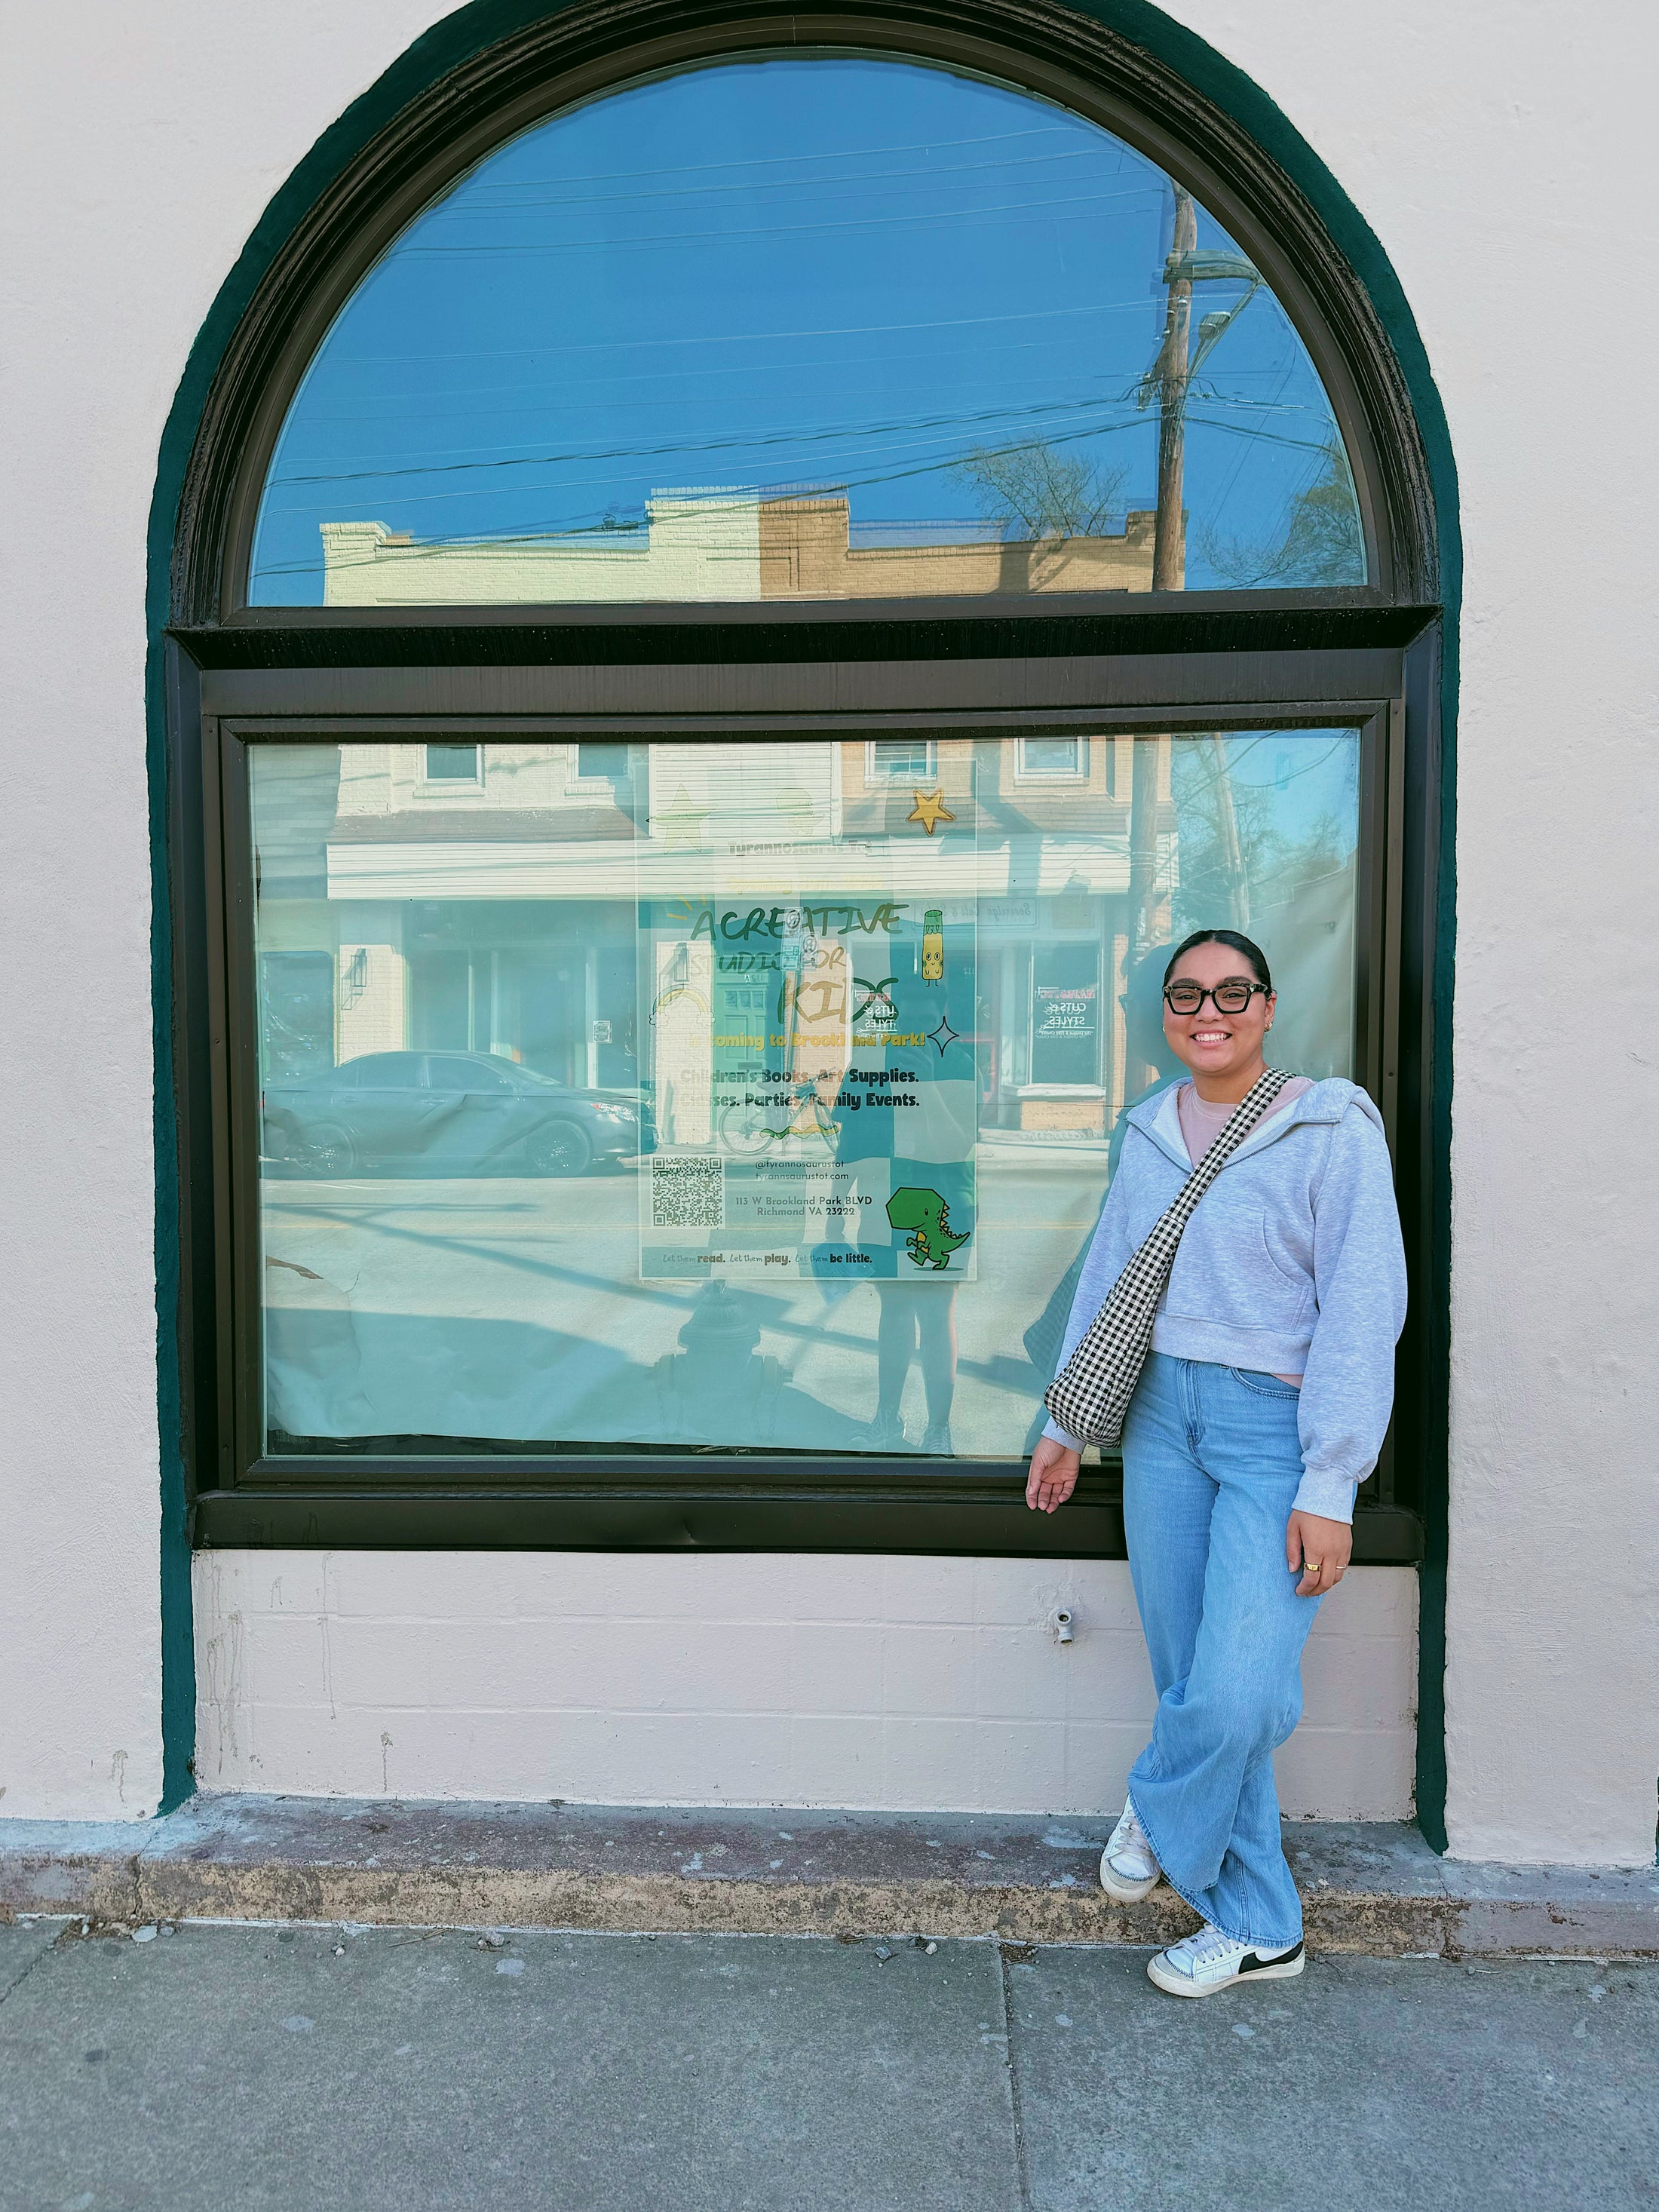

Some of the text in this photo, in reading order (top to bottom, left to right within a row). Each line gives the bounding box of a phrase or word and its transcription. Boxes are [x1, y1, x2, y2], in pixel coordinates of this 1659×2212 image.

[805, 946, 847, 970] OR
[769, 1034, 787, 1048] to
[881, 1031, 925, 1047] Park!
[849, 1068, 919, 1088] Supplies.
[866, 1093, 920, 1107] Events.
[735, 1196, 872, 1205] 113 W Brookland Park BLVD
[757, 1207, 855, 1216] Richmond VA 23222
[697, 1253, 725, 1263] read.
[729, 1253, 743, 1262] Let
[744, 1253, 762, 1262] them
[764, 1253, 791, 1266] play.
[830, 1253, 843, 1263] be
[845, 1253, 872, 1263] little.
